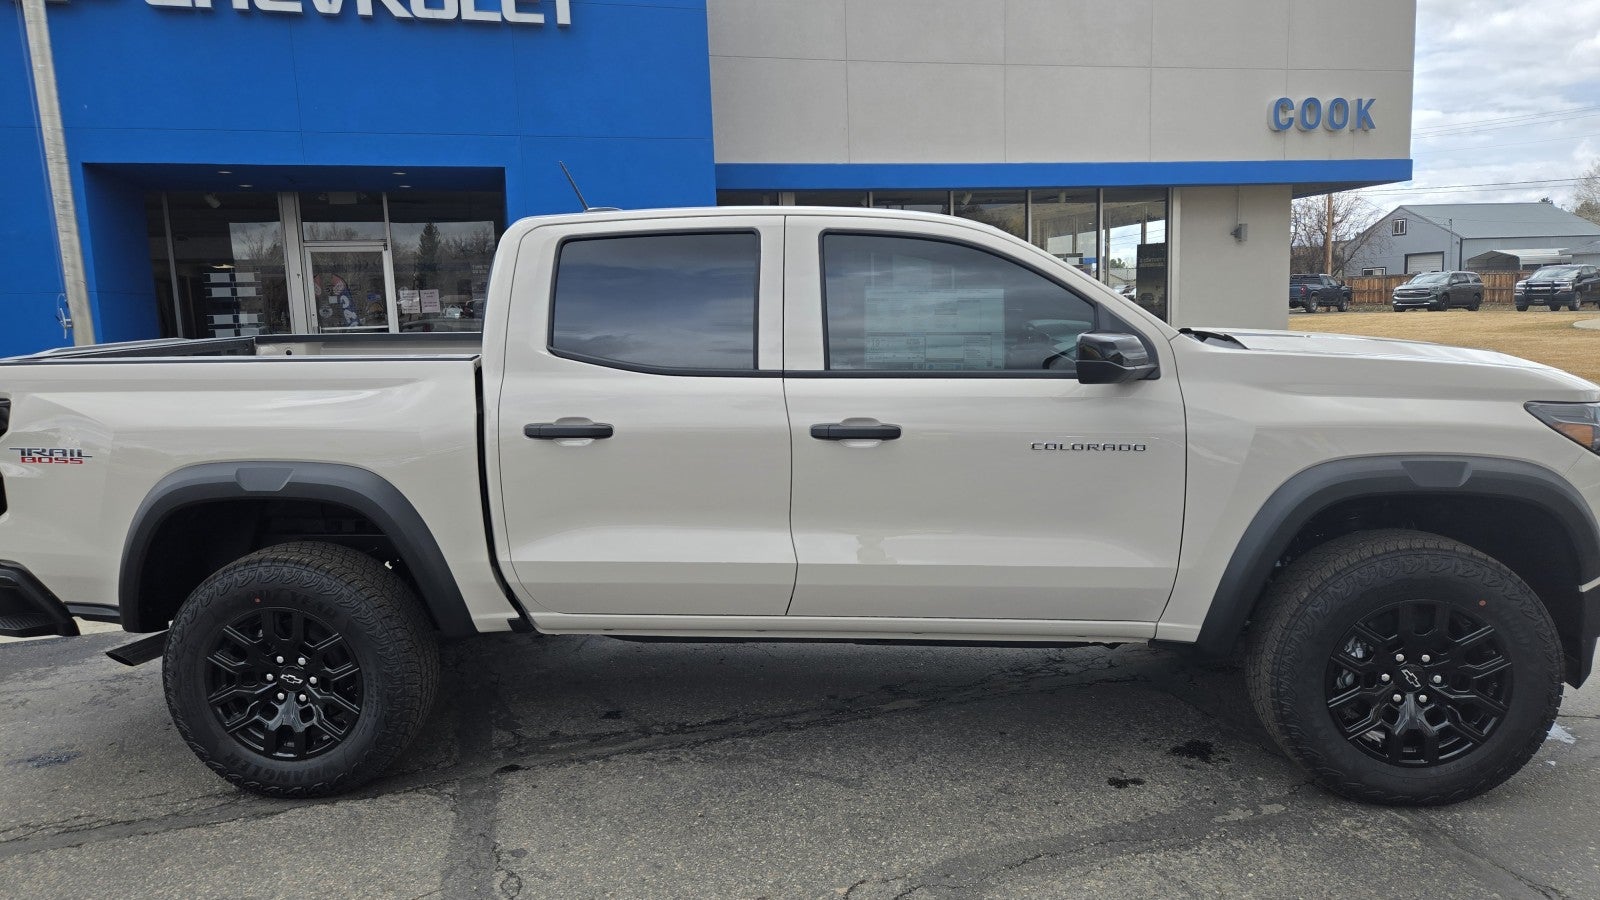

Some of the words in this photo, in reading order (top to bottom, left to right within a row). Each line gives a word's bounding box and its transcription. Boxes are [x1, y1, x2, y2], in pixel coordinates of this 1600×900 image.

[1270, 97, 1376, 131] COOK
[1031, 442, 1146, 451] COLORADO
[9, 447, 93, 458] TRAIL
[21, 456, 83, 465] BOSS
